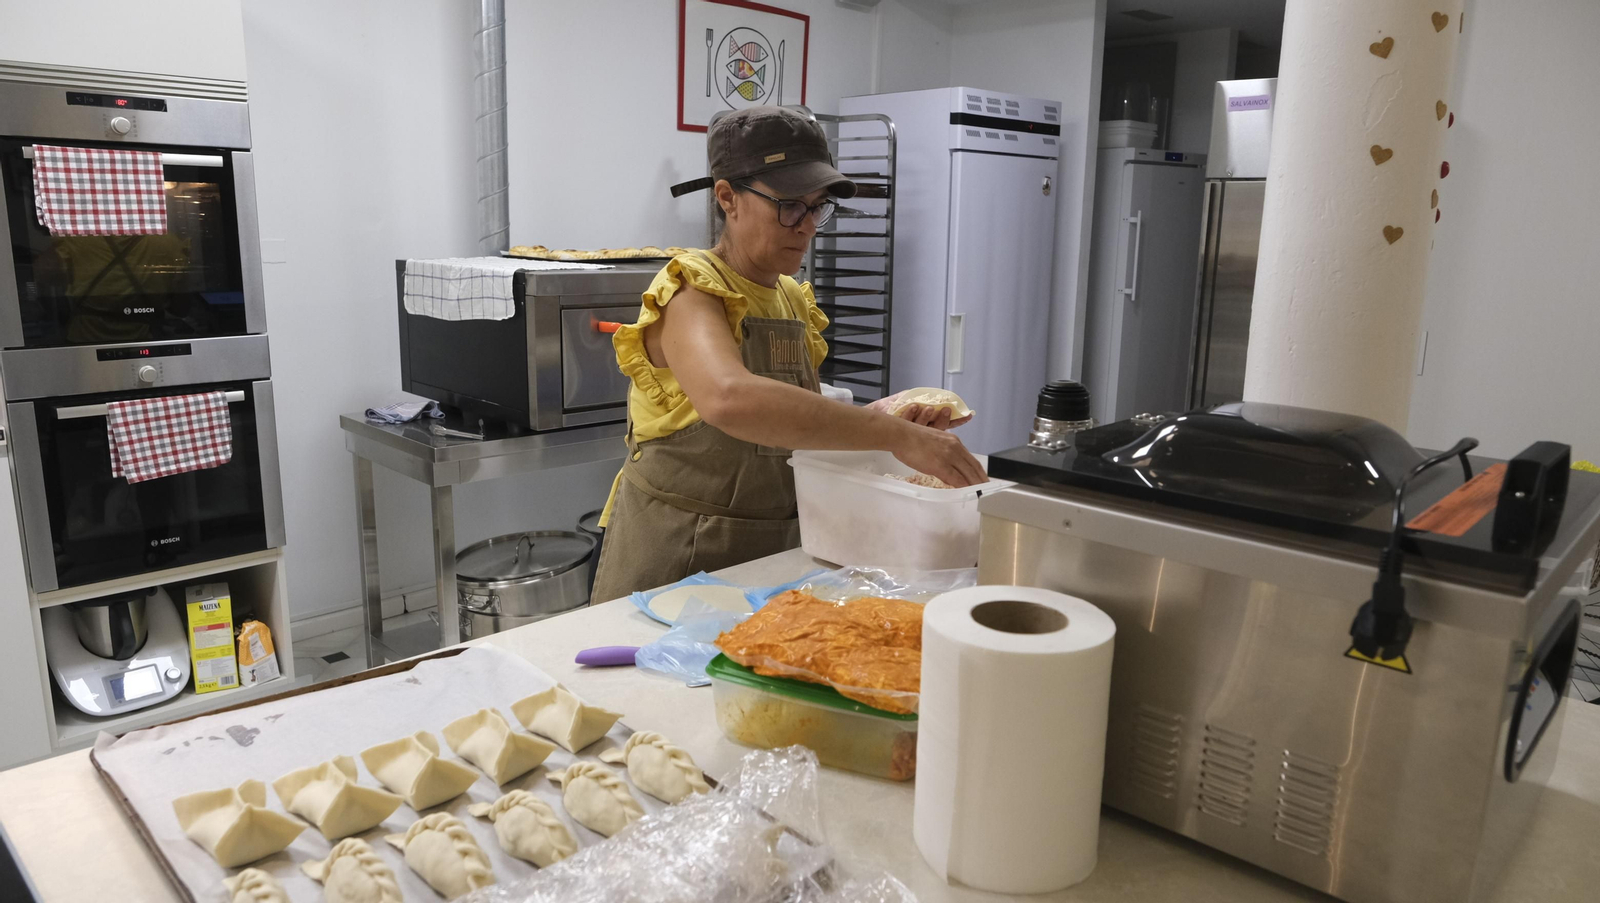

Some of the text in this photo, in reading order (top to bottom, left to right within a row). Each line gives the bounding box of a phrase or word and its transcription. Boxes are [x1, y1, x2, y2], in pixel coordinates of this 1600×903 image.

[1230, 99, 1269, 107] SALVAINOX
[160, 536, 181, 545] BOSCH
[198, 602, 221, 612] MAIZENA
